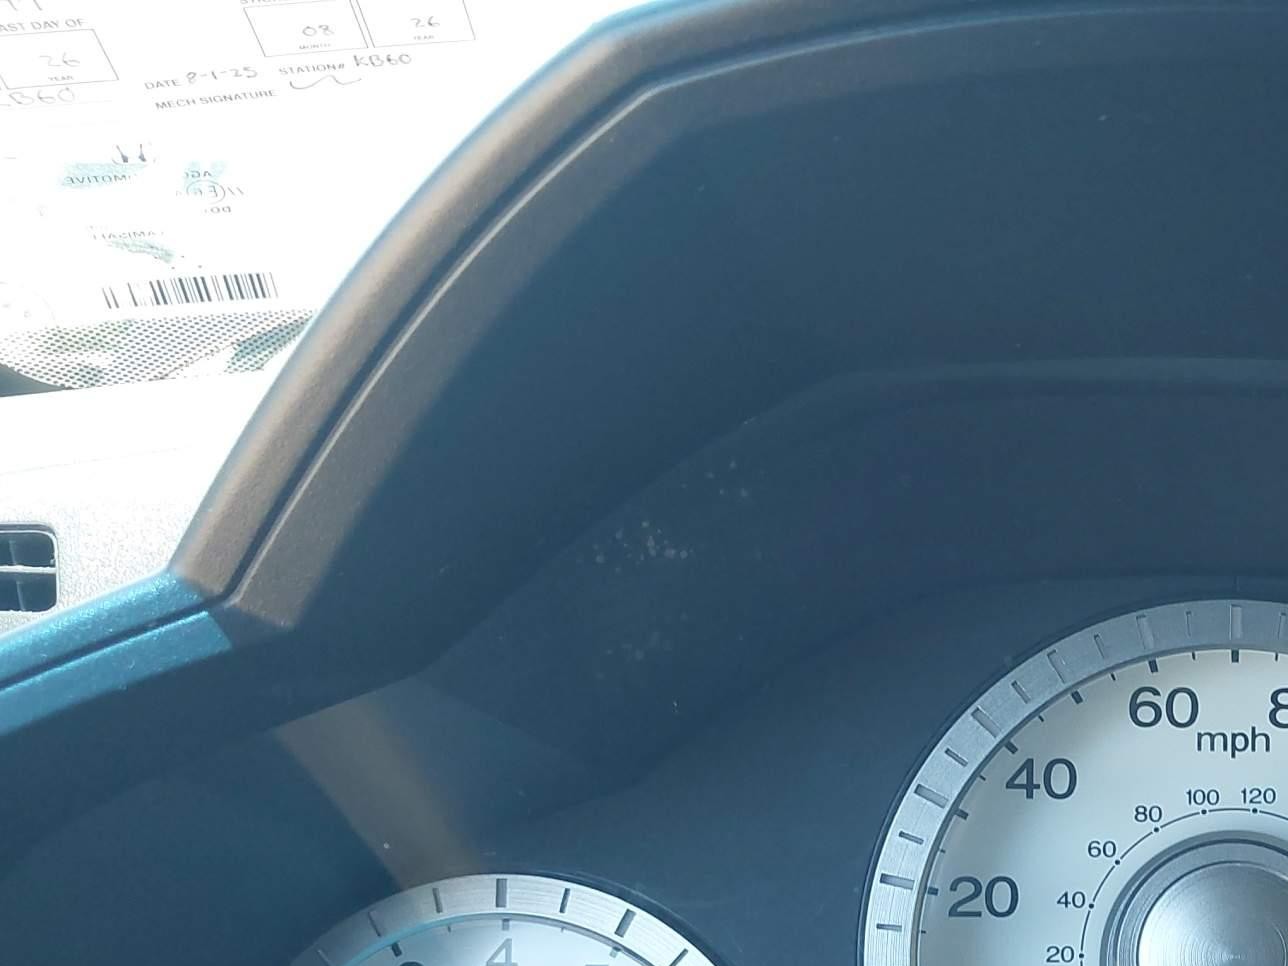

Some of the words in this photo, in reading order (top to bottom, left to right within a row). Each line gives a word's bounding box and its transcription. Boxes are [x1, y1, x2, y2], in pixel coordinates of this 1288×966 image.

[30, 19, 59, 31] DAY
[65, 17, 87, 28] OF
[410, 15, 441, 28] 26
[143, 79, 182, 91] DATE
[154, 98, 197, 111] MECH
[199, 89, 279, 105] SIGNATURE
[1127, 686, 1200, 729] 60
[1196, 726, 1271, 759] mph
[1004, 757, 1078, 801] 40
[1186, 789, 1220, 806] 100
[1240, 787, 1277, 805] 120
[1133, 805, 1163, 824] 80
[1087, 840, 1117, 858] 60
[947, 875, 1020, 918] 20
[1056, 891, 1086, 909] 40
[1045, 945, 1075, 964] 20
